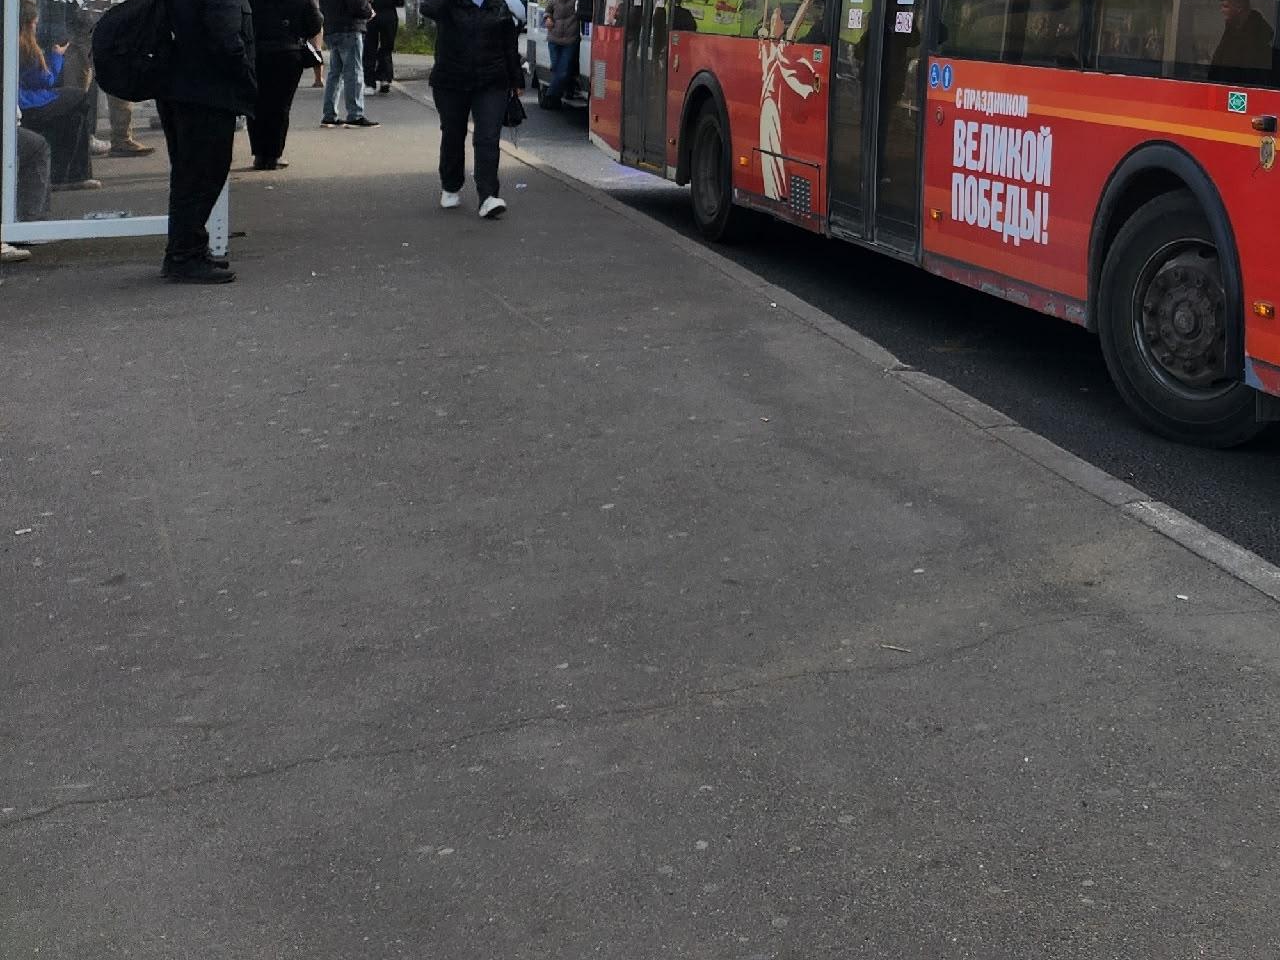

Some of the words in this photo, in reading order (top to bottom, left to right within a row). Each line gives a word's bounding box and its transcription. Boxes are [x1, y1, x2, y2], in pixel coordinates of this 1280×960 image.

[955, 87, 963, 109] С
[963, 89, 1028, 118] ПРАЗДНИКОМ
[953, 119, 1053, 187] ВЕЛИКОЙ
[951, 172, 1049, 247] ПОБЕДЫ!
